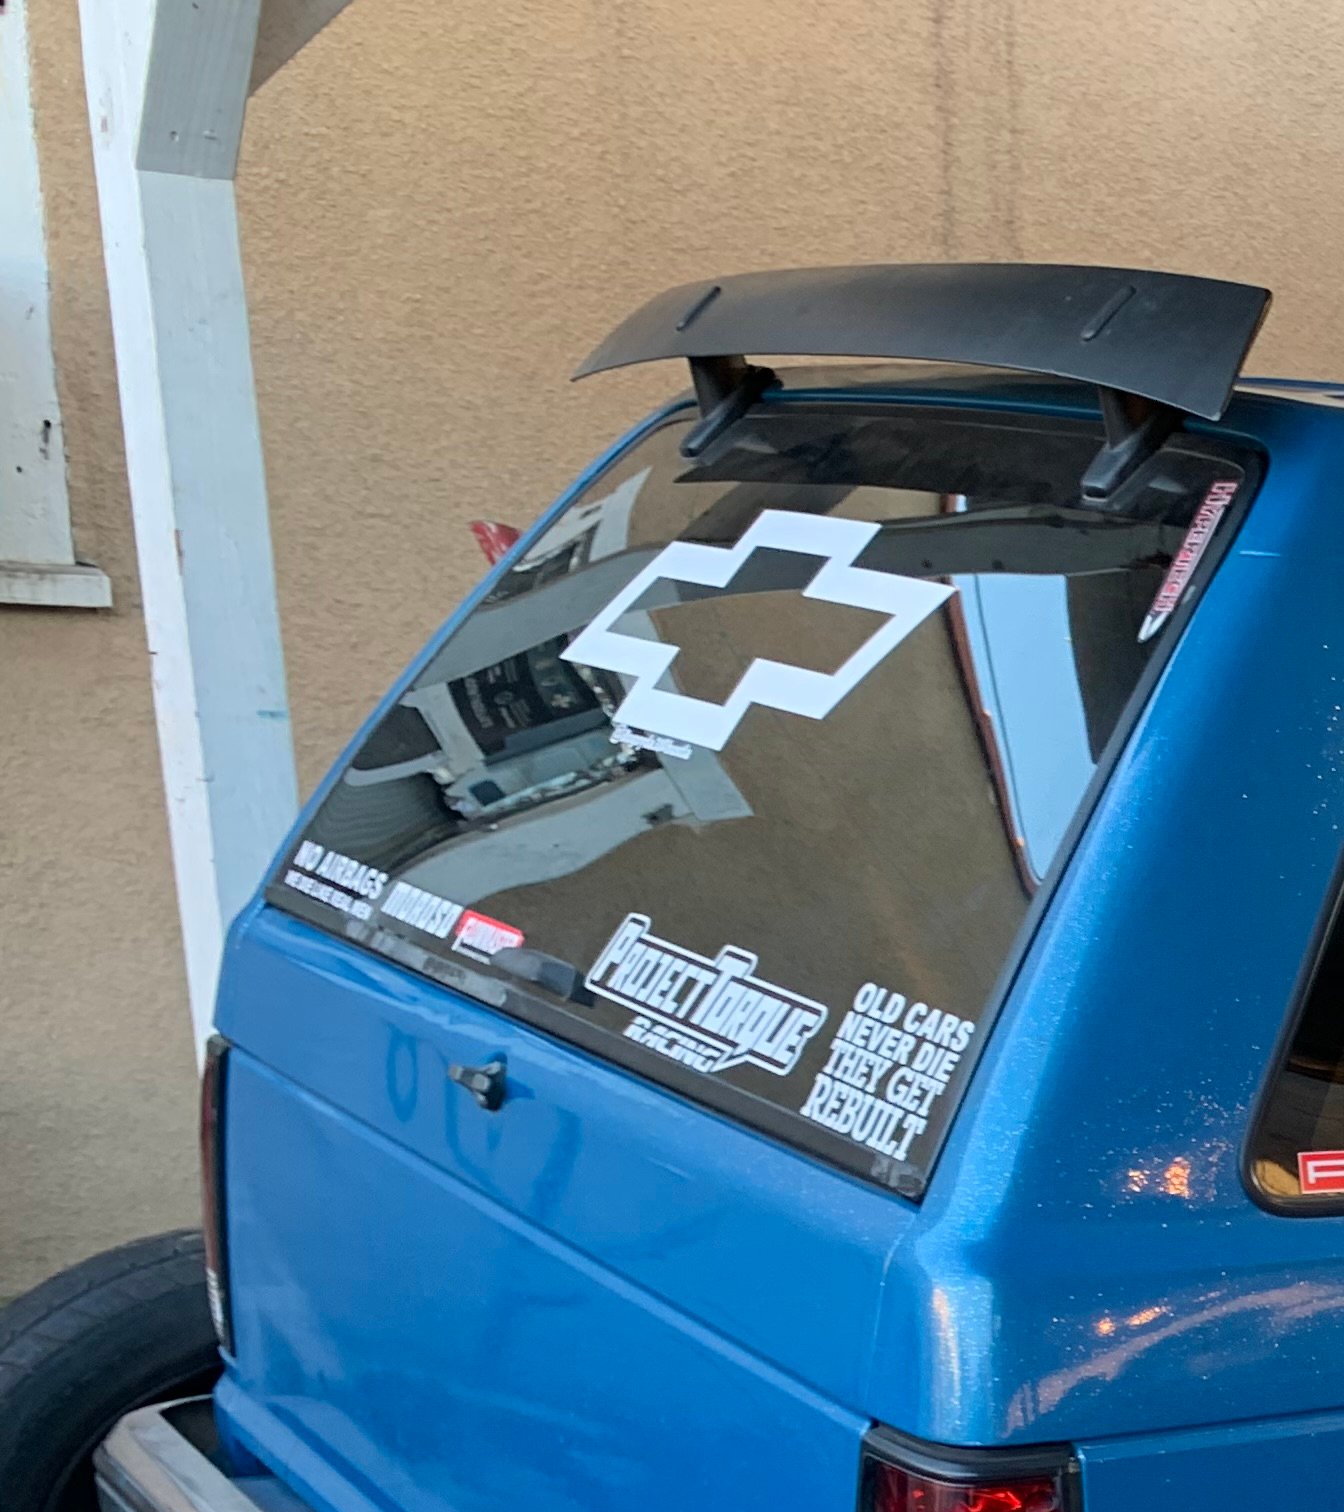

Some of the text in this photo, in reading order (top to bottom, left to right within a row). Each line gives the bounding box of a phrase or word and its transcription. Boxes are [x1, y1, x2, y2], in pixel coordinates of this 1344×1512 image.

[293, 840, 388, 900] NO AIRBAGS
[591, 920, 717, 1019] PROJECT
[690, 952, 822, 1065] TORQUE
[853, 982, 976, 1052] OLD CARS
[622, 1014, 724, 1073] RACING
[823, 1038, 947, 1118] THEY GET
[836, 1011, 961, 1082] NEVER DIE
[800, 1073, 928, 1161] REBUILT
